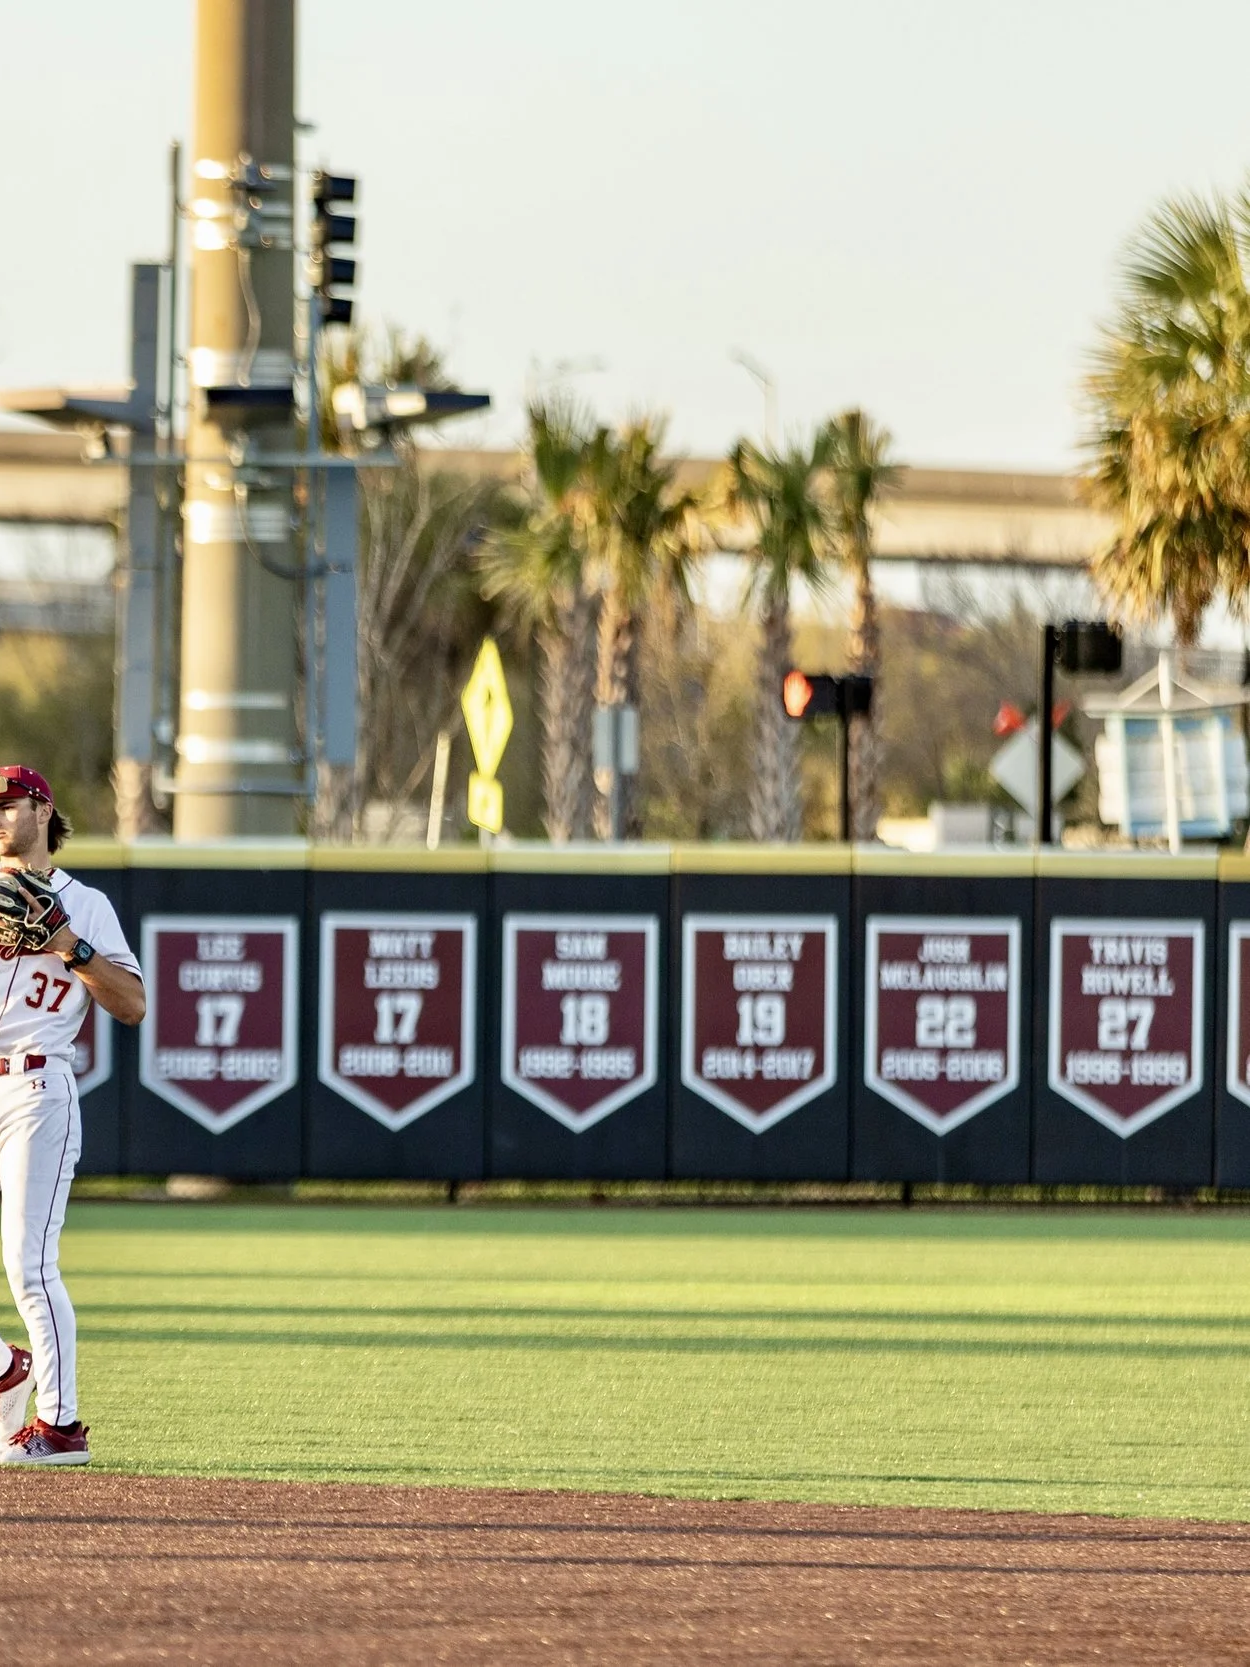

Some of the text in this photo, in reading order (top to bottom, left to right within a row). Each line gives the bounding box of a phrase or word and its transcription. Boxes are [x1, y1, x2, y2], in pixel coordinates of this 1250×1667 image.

[555, 932, 609, 960] SAM
[917, 934, 972, 964] JOSH
[1088, 936, 1170, 965] TRAVIS
[25, 971, 72, 1013] 37
[1080, 966, 1176, 997] HOWELL
[195, 995, 246, 1047] 17
[374, 990, 424, 1044] 17
[559, 992, 610, 1046] 18
[735, 993, 786, 1047] 19
[915, 995, 978, 1049] 22
[1097, 998, 1156, 1051] 27
